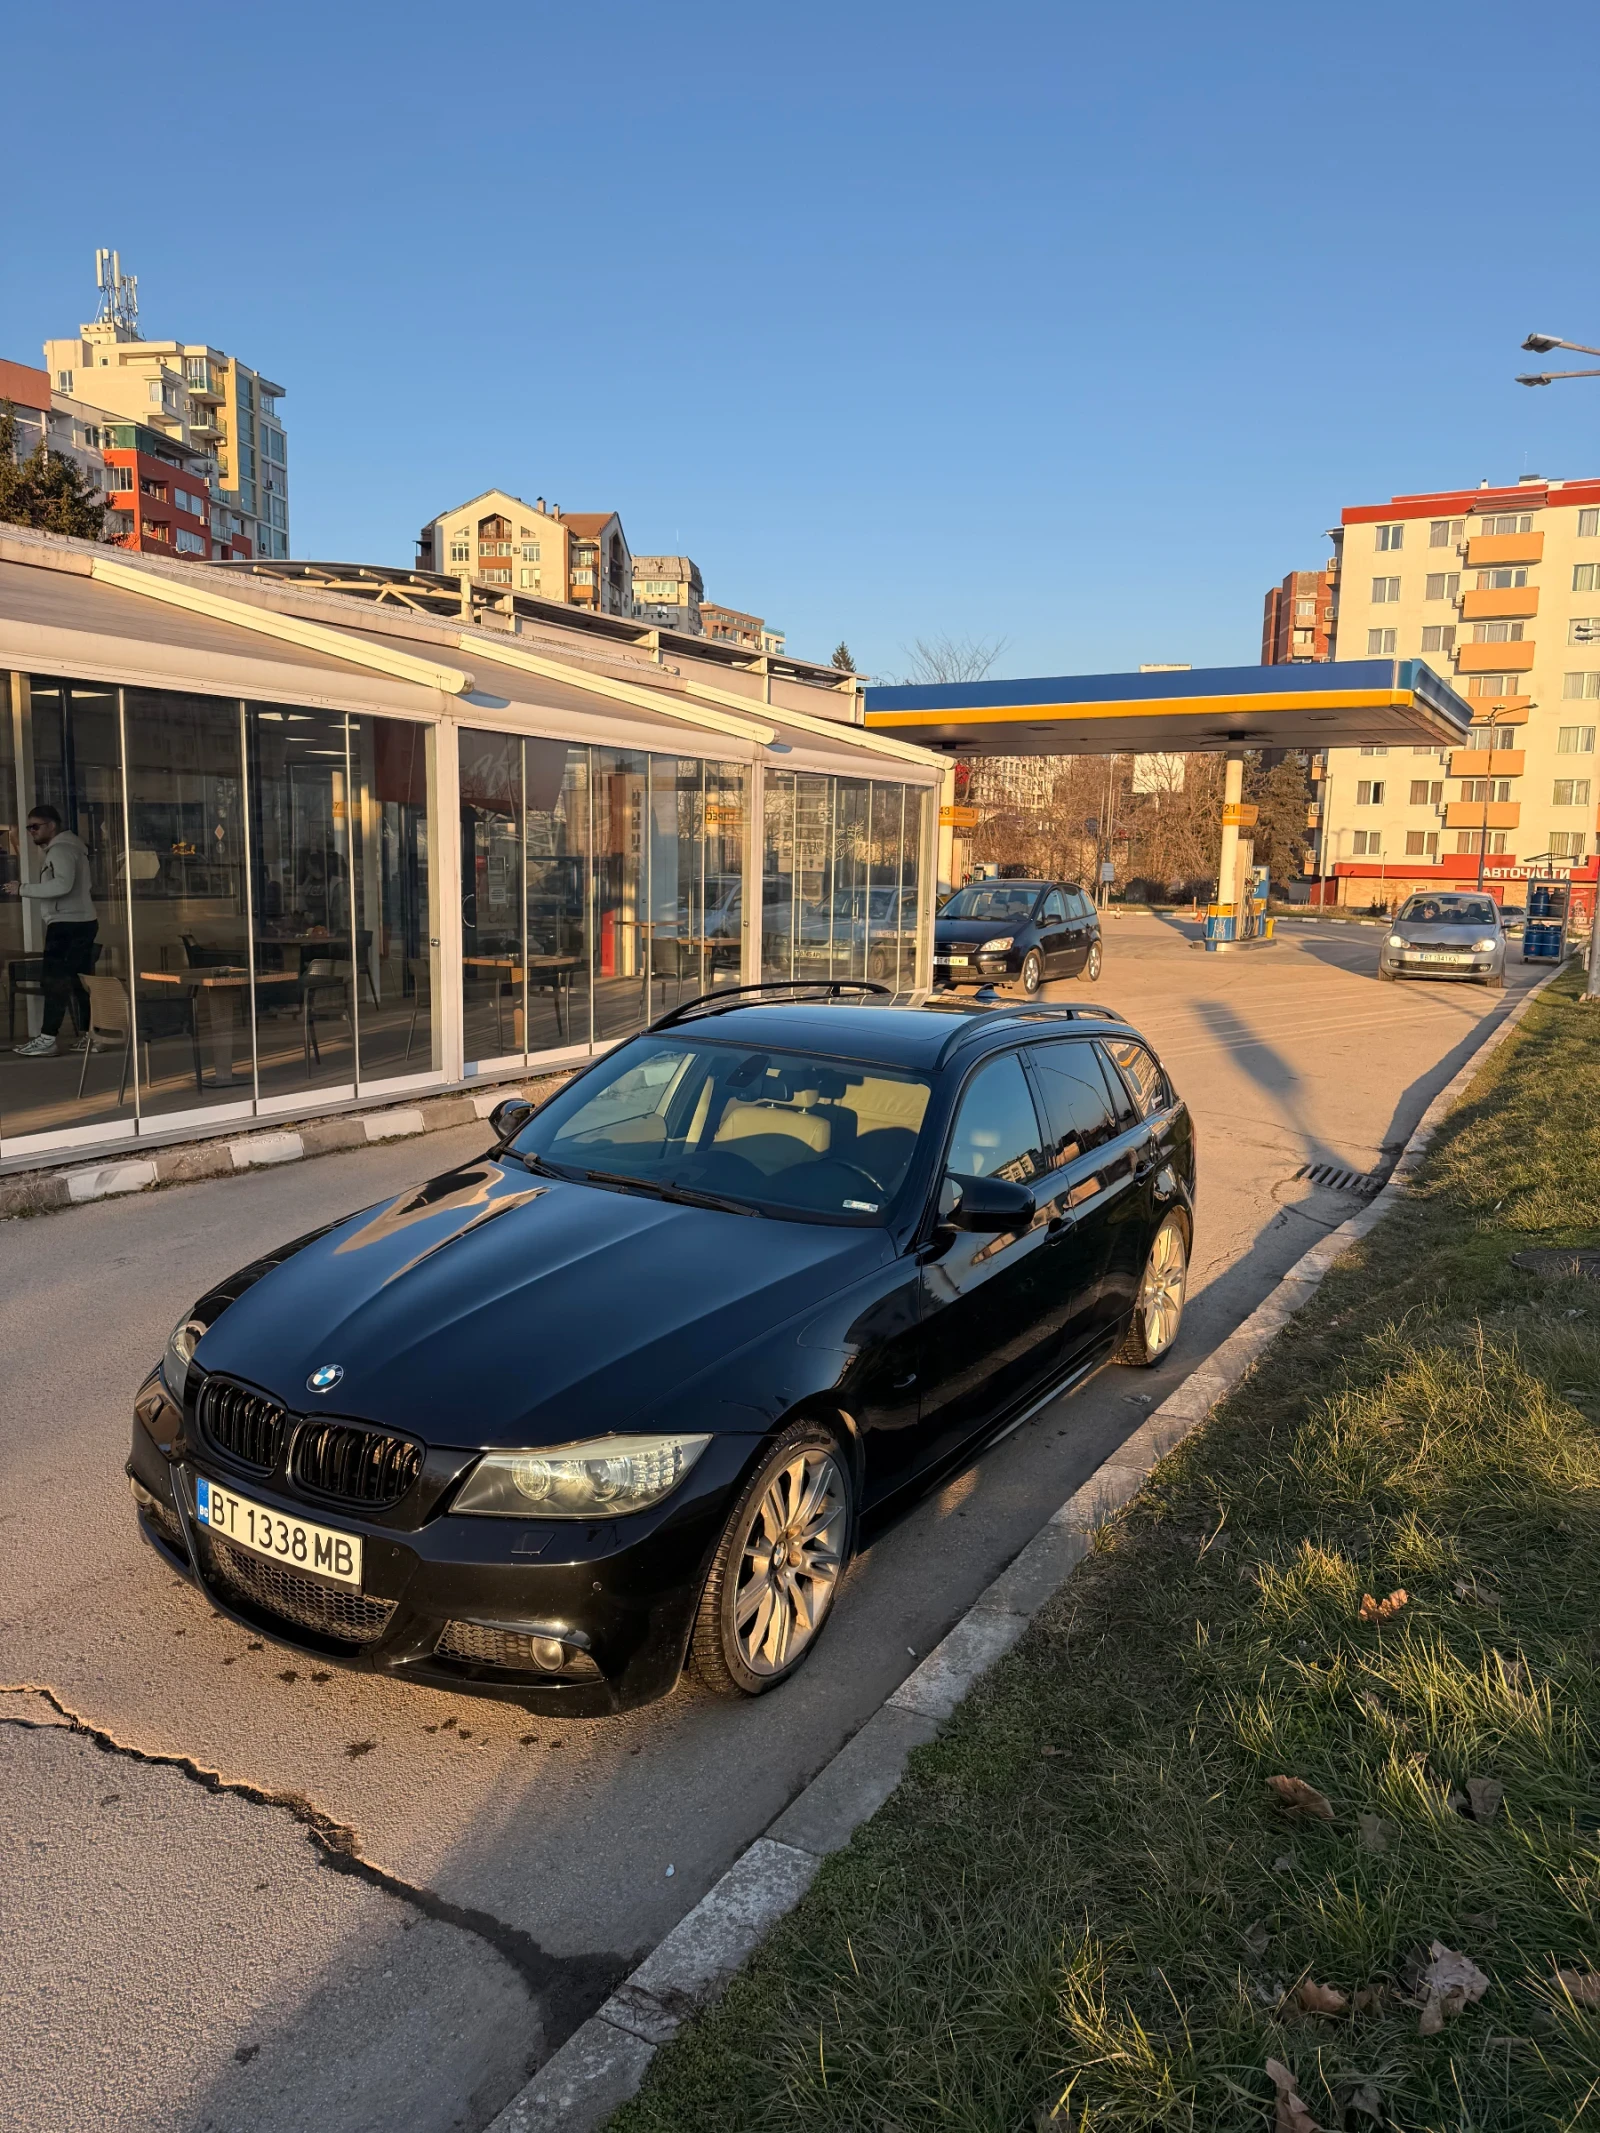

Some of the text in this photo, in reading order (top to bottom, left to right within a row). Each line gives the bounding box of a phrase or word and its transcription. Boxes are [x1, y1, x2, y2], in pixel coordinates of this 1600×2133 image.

[1224, 804, 1236, 814] 21
[1483, 867, 1571, 879] АВТОЧАСТИ
[199, 1504, 209, 1518] BG
[212, 1490, 354, 1576] BT 1338 MB
